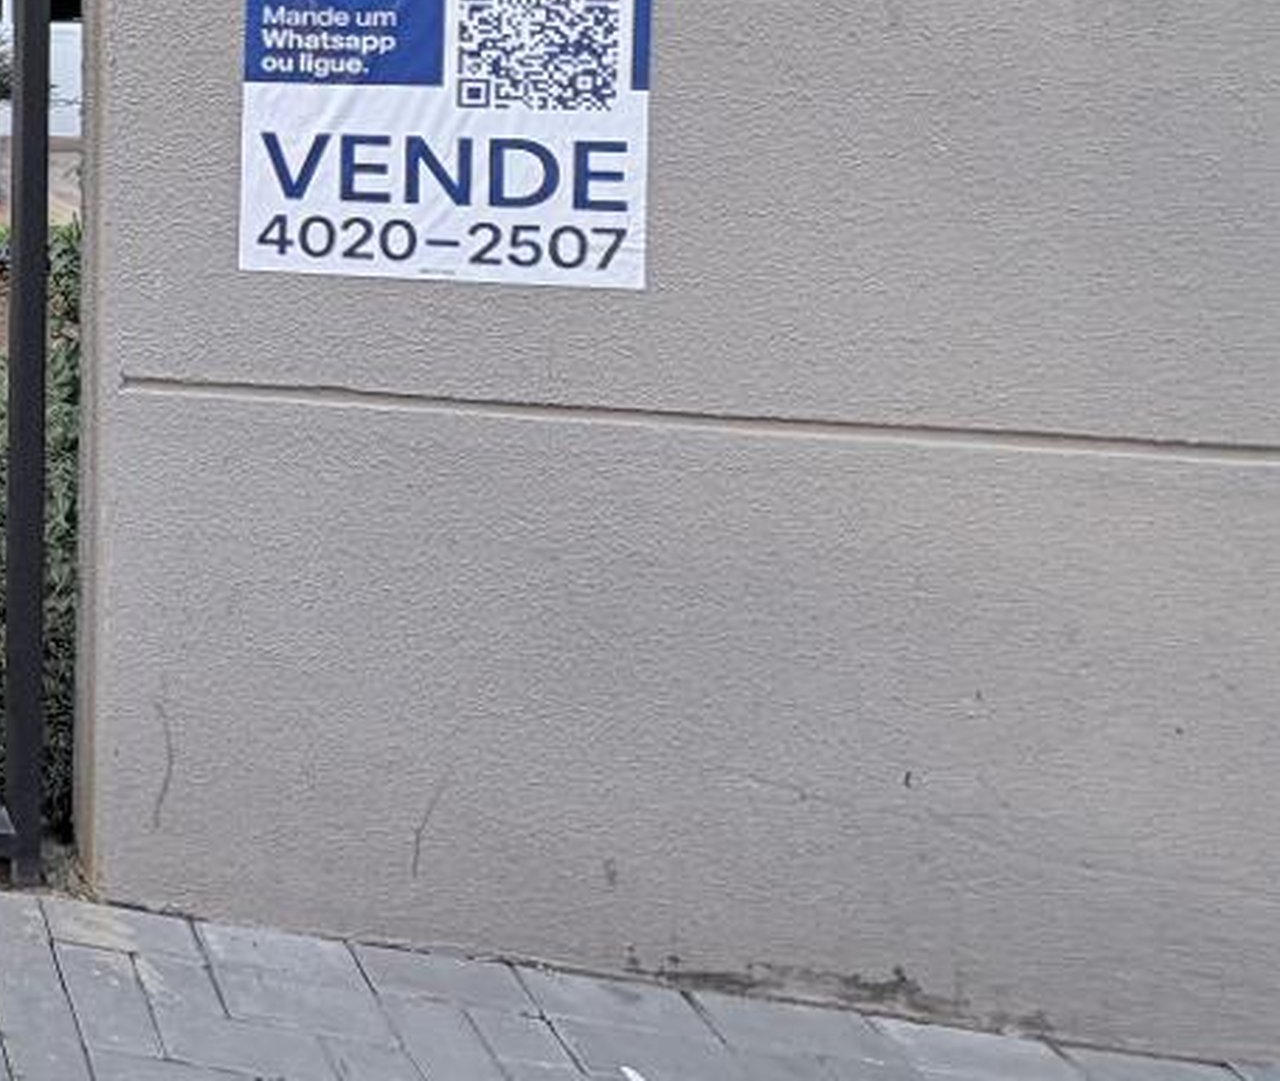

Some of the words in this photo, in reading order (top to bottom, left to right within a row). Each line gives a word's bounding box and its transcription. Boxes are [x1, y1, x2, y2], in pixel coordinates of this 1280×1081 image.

[263, 5, 350, 27] Mande
[356, 11, 397, 27] um
[261, 29, 397, 55] Whatsapp
[261, 56, 294, 73] ou
[300, 52, 370, 78] ligue.
[260, 132, 629, 213] VENDE
[256, 214, 629, 272] 4020-2507
